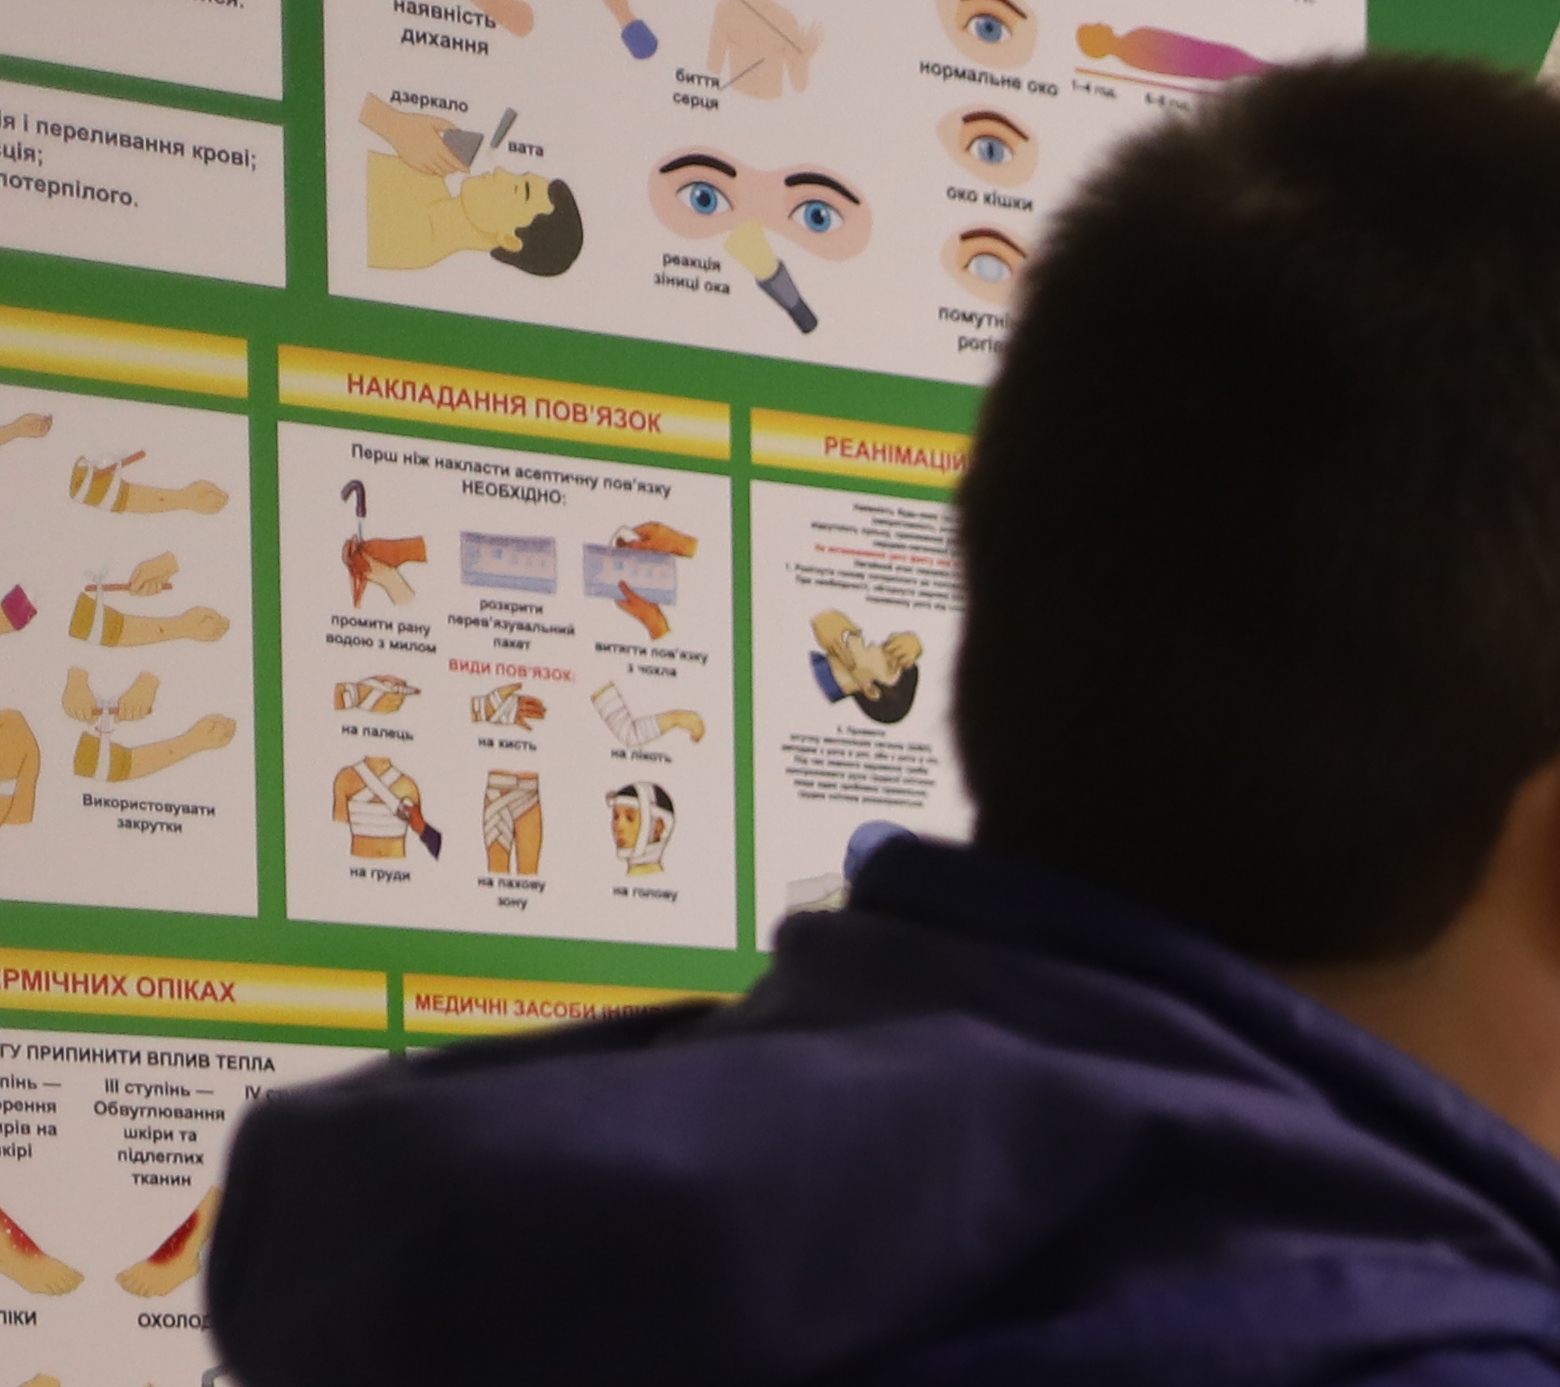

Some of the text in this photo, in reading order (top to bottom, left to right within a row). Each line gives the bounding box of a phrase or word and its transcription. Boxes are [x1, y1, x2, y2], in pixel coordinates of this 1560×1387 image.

[393, 0, 496, 29] наявність
[401, 29, 489, 55] дихання
[676, 68, 719, 88] биття
[920, 61, 1058, 96] нормальне око
[390, 90, 468, 112] дзеркало
[673, 93, 719, 111] серця
[36, 119, 184, 157] переливання
[192, 145, 257, 172] крові;
[508, 141, 544, 157] вата
[946, 186, 1033, 211] око кішки
[704, 280, 731, 295] ока
[347, 373, 661, 433] НАКЛАДАННЯ ПОВ'ЯЗОК
[352, 444, 398, 465] Перш
[404, 450, 429, 466] ніж
[435, 457, 510, 477] накласти
[515, 466, 597, 489] асептичну
[462, 480, 566, 505] НЕОБХІДНО:
[331, 614, 431, 637] промити рану
[326, 633, 373, 649] водою
[390, 641, 436, 654] милом
[449, 659, 491, 675] ВИДИ
[342, 725, 414, 742] на палець
[82, 793, 215, 817] Використовувати
[117, 817, 183, 833] закрутки
[350, 867, 410, 884] на груди
[0, 968, 235, 1003] РМІЧНИХ ОПІКАХ
[415, 992, 507, 1017] МЕДИЧНІ
[514, 1000, 595, 1020] ЗАСОБИ
[27, 1044, 141, 1066] ПРИПИНИТИ
[149, 1051, 210, 1069] ВПЛИВ
[216, 1054, 275, 1072] ТЕПЛА
[125, 1080, 190, 1102] ступінь
[94, 1101, 225, 1121] Обвуглювання
[37, 1125, 57, 1136] на
[124, 1126, 197, 1143] шкіри та
[118, 1148, 204, 1165] підлеглих
[132, 1171, 191, 1186] тканин
